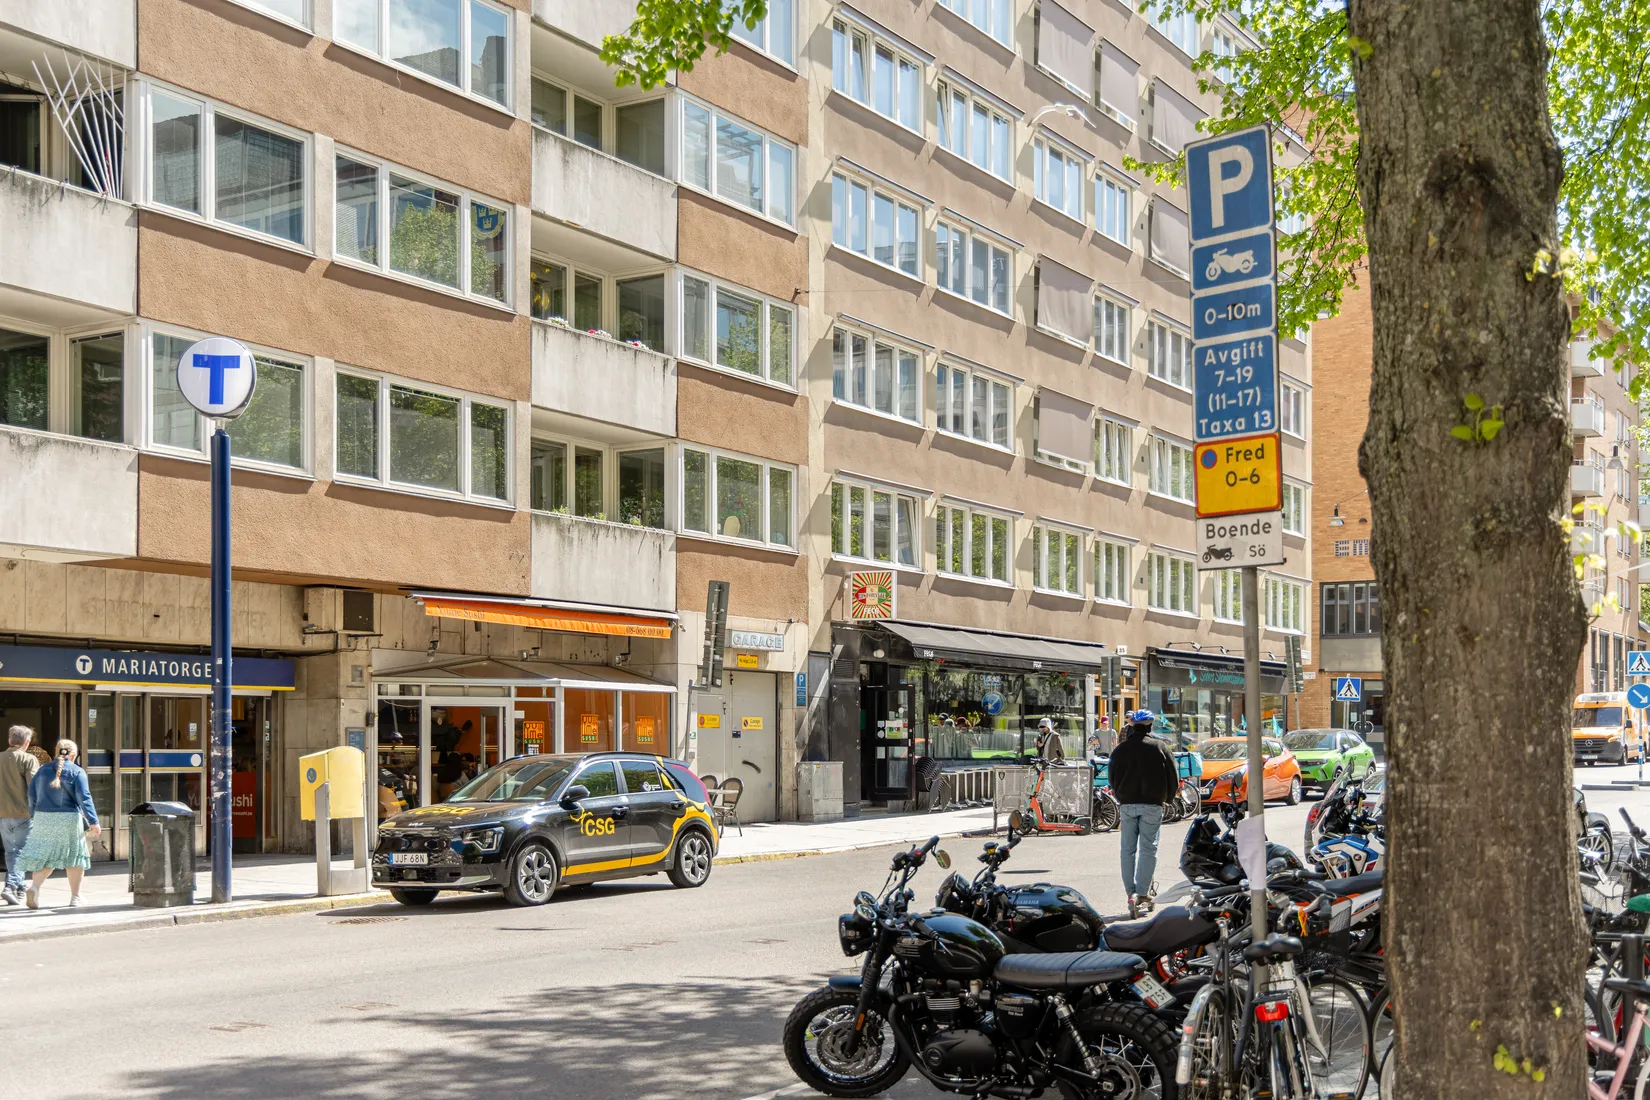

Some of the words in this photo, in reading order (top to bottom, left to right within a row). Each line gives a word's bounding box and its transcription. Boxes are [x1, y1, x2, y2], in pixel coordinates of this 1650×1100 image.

[1208, 144, 1254, 229] P
[1204, 340, 1263, 366] Avgift
[192, 353, 241, 405] T
[1215, 365, 1253, 387] 7-19
[1208, 386, 1261, 412] (11-17)
[1199, 418, 1246, 436] Taxa
[1253, 410, 1272, 429] 13
[1225, 443, 1265, 464] Fred
[1225, 468, 1261, 487] 0-6
[1206, 518, 1272, 539] Boende
[1249, 544, 1266, 557] Sö
[732, 633, 782, 649] GARAGE
[80, 658, 90, 672] T
[102, 658, 212, 678] MARIATORGE
[798, 674, 804, 686] P
[585, 816, 615, 837] CSG
[395, 853, 408, 863] JJF
[410, 853, 425, 863] 68N
